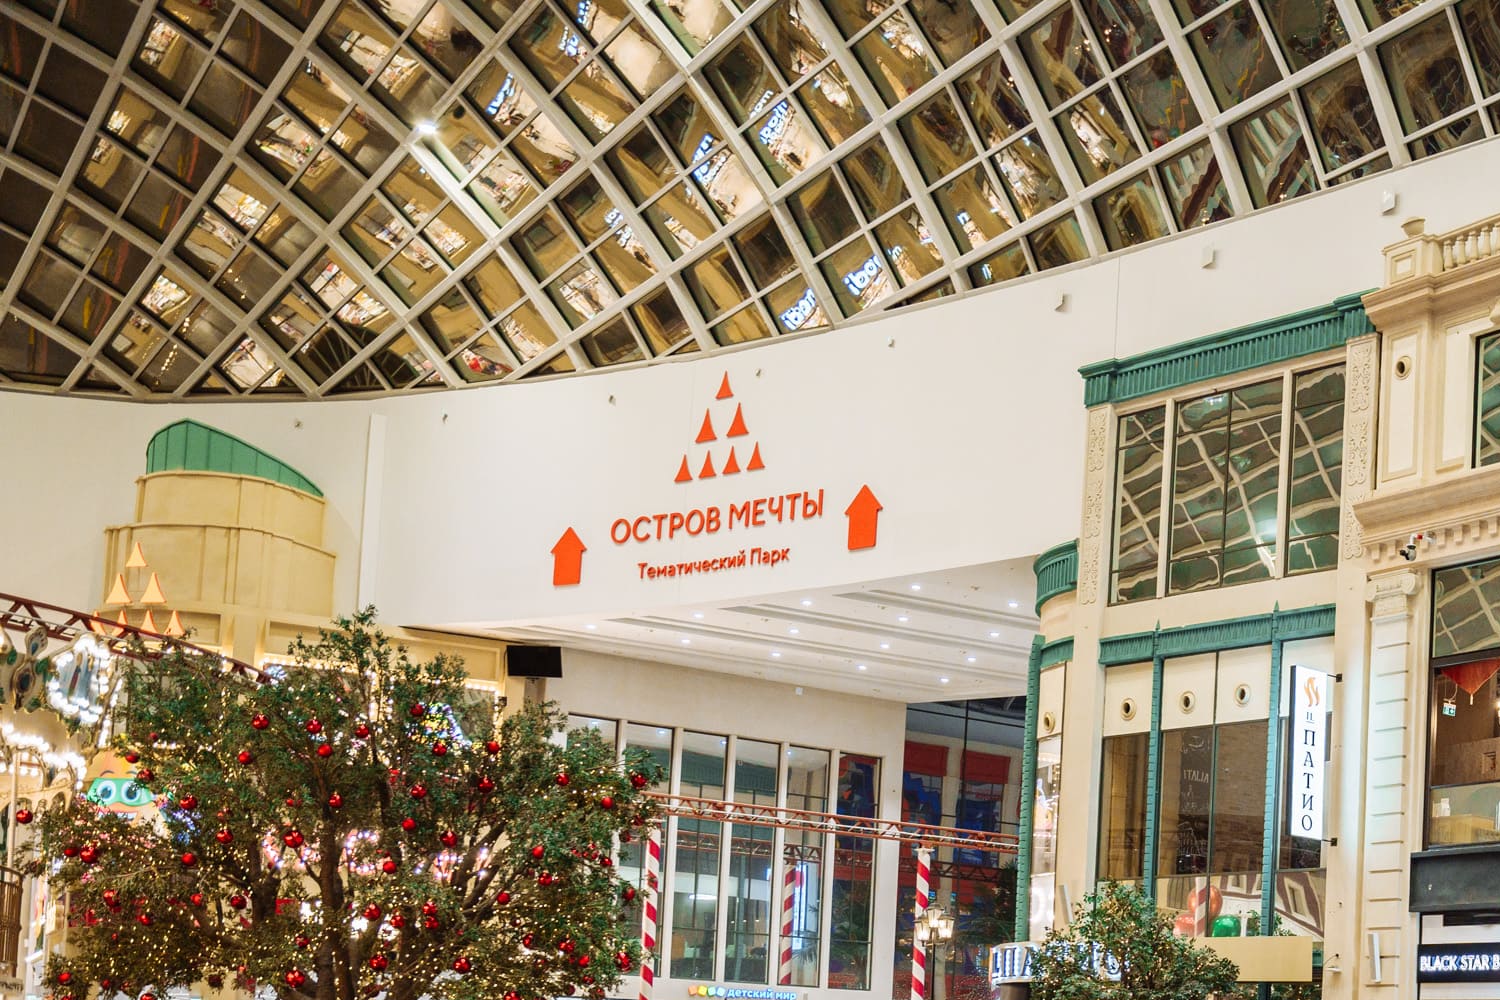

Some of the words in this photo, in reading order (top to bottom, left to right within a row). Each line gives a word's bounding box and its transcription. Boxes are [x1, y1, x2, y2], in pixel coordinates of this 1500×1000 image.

[610, 506, 721, 545] ОСТРОВ
[728, 488, 825, 530] МЕЧТЫ
[637, 550, 746, 579] Тематический
[750, 547, 791, 567] Парк
[1301, 728, 1316, 831] ПАТИО
[1420, 955, 1458, 972] BLACK
[1460, 954, 1490, 971] STAR
[727, 988, 774, 999] детский
